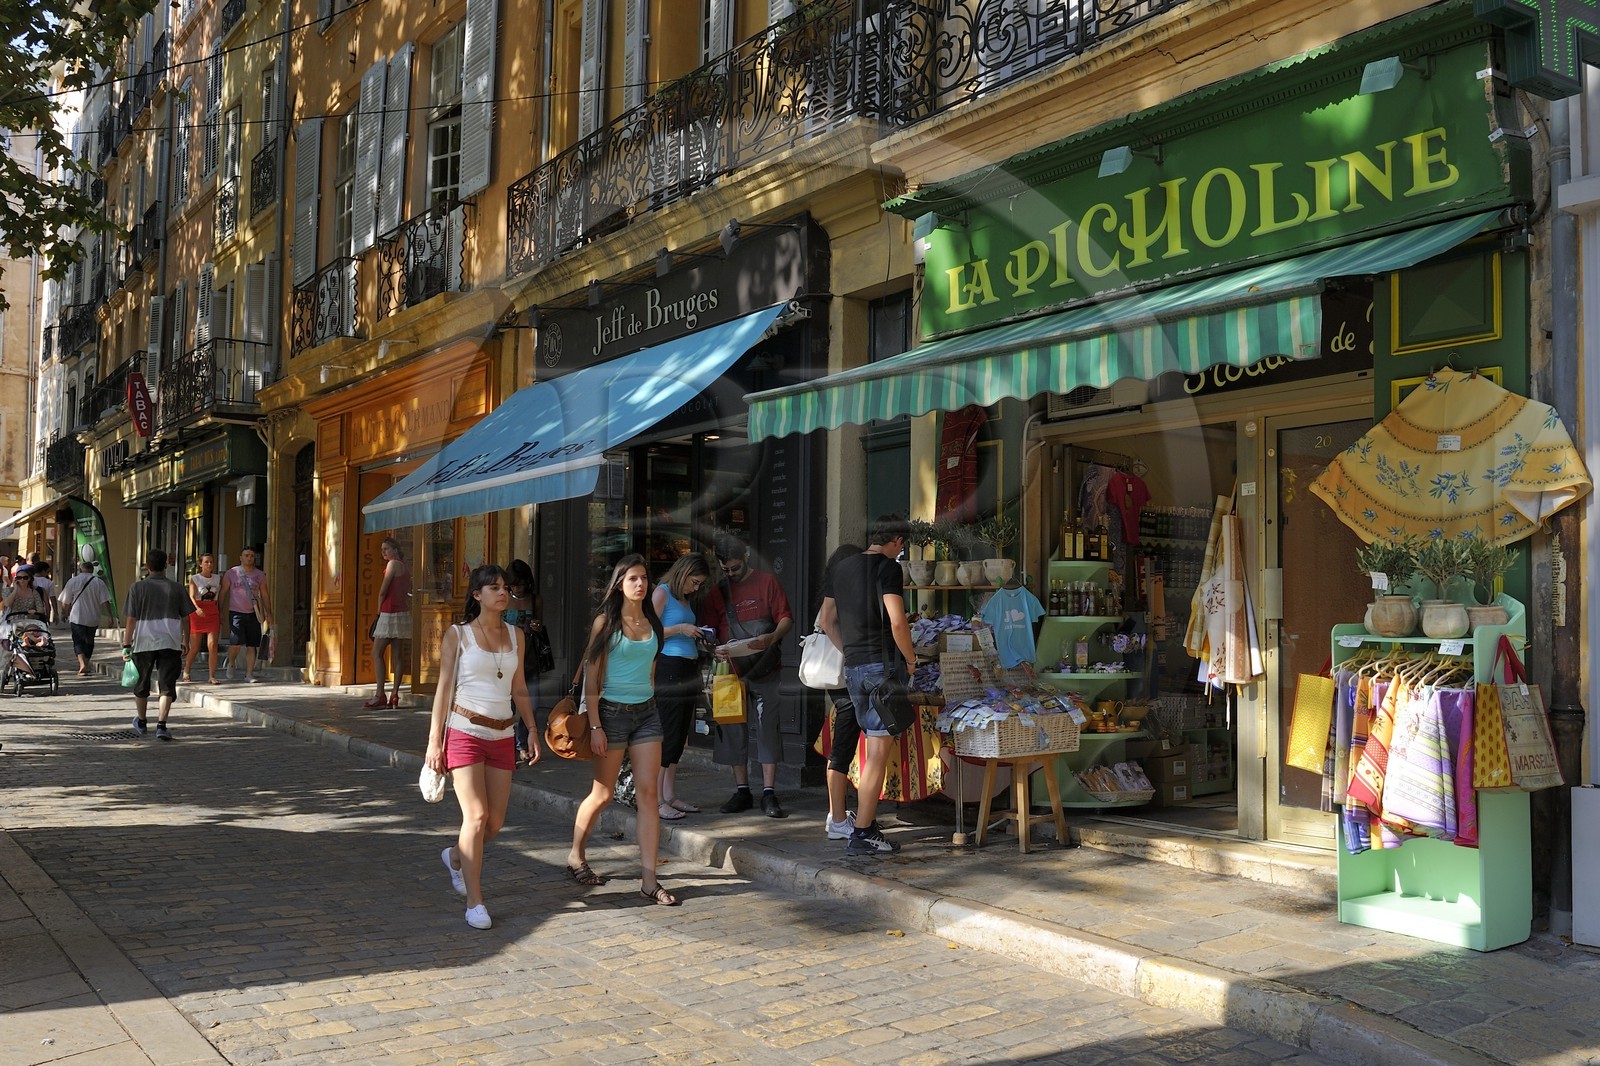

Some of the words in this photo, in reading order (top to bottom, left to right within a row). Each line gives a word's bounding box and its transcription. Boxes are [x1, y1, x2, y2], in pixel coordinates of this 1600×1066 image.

[945, 259, 999, 315] LA
[1004, 126, 1460, 298] PICHOLINE
[592, 304, 626, 356] Jeff
[627, 314, 641, 337] de
[642, 288, 719, 330] Bruges
[1330, 321, 1356, 353] de
[133, 381, 149, 430] TABAC
[1315, 436, 1332, 449] 20
[362, 538, 373, 673] ISCUITIER
